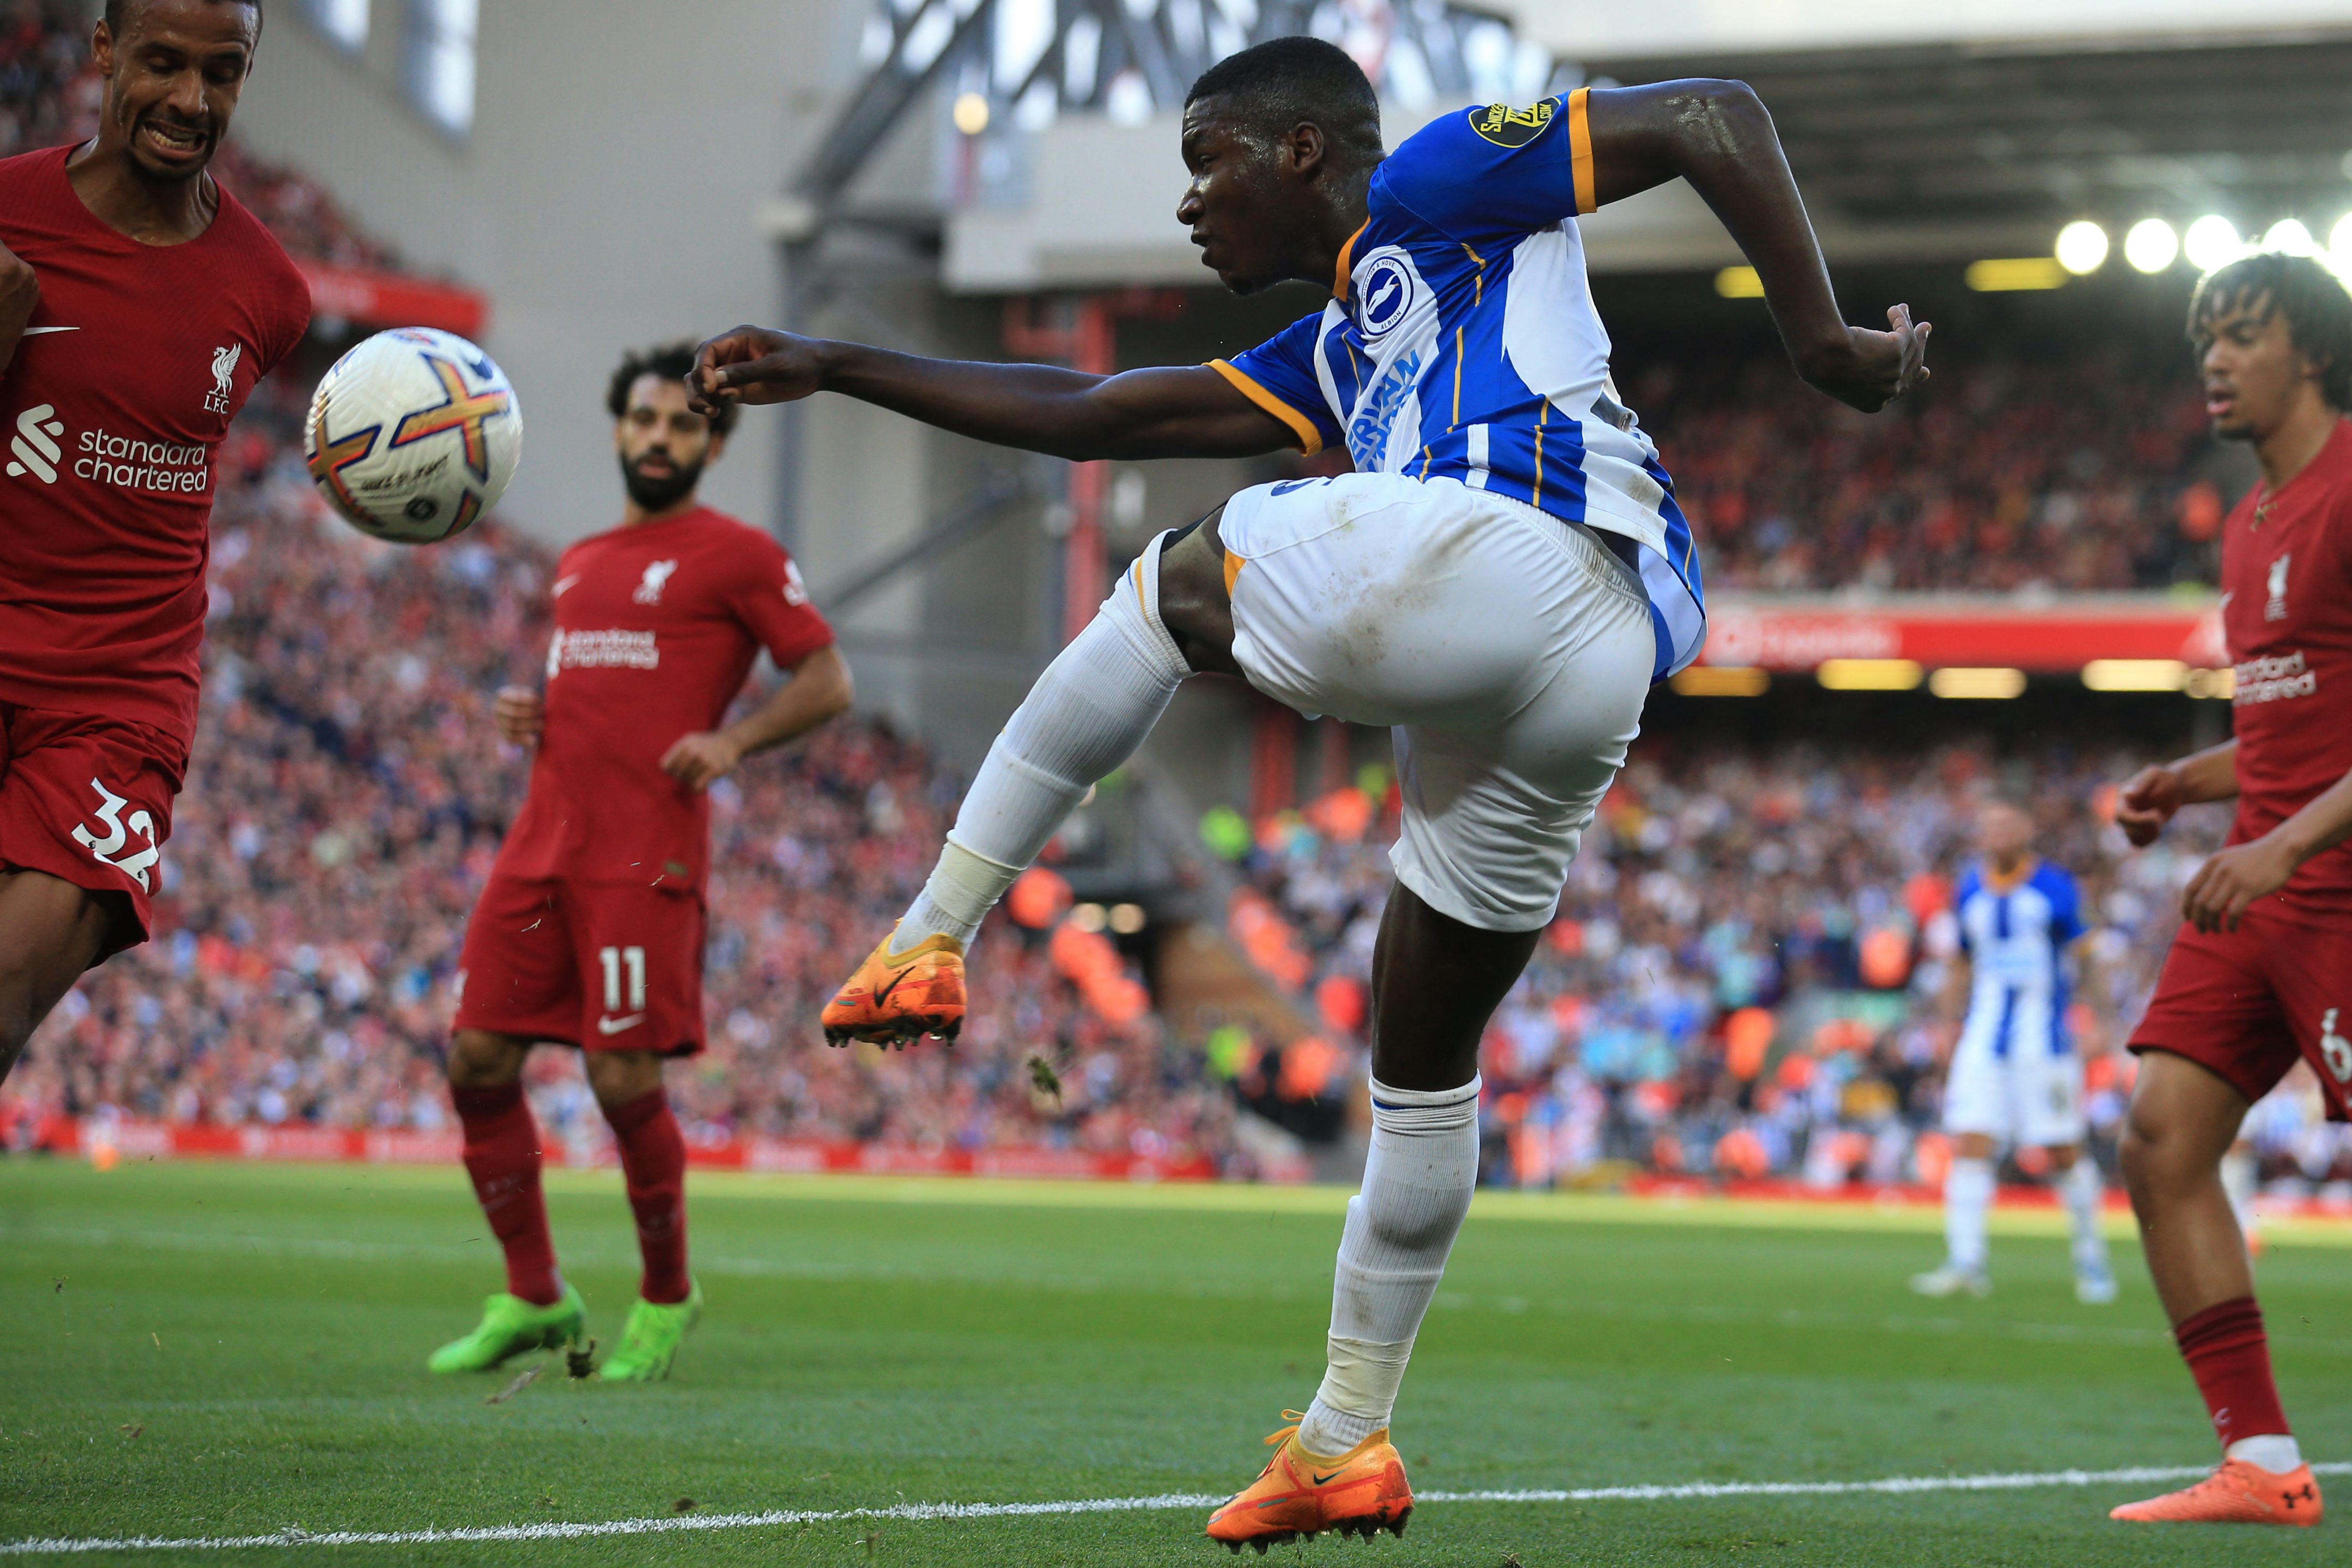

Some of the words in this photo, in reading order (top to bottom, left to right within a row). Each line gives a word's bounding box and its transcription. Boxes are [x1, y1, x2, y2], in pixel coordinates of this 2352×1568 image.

[1362, 267, 1376, 302] BRIGHTON
[1381, 310, 1402, 330] ALBION
[1348, 349, 1421, 464] ERICAN
[78, 428, 207, 465] standard
[74, 456, 207, 492] chartered
[71, 777, 160, 894] 32
[599, 946, 646, 1011] 11
